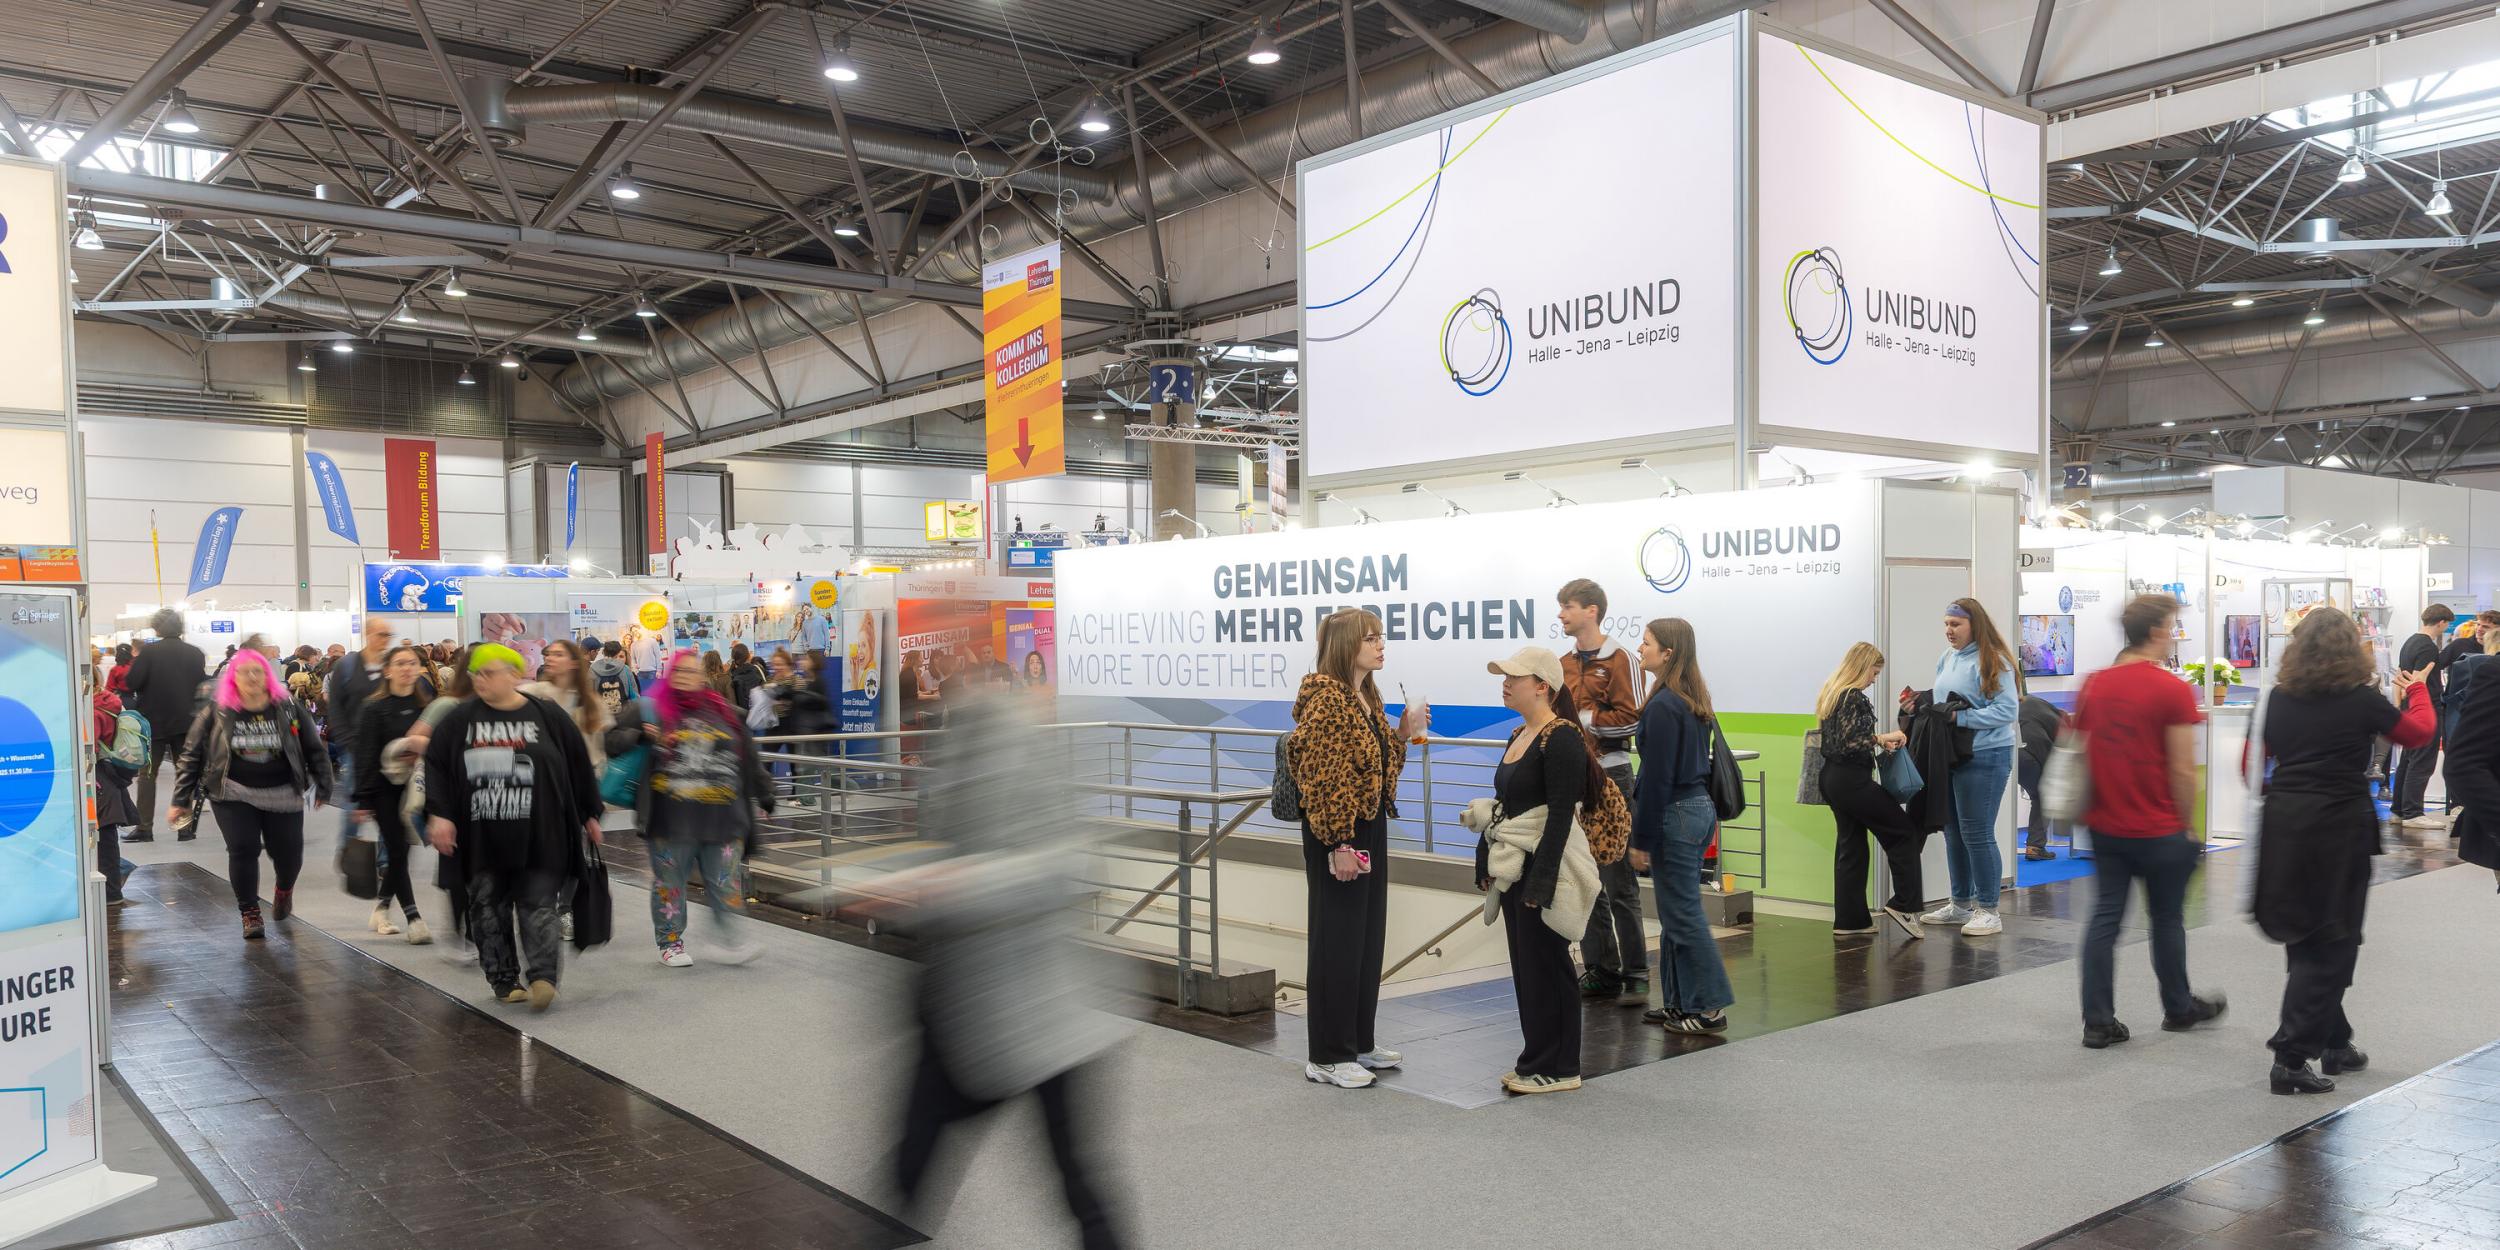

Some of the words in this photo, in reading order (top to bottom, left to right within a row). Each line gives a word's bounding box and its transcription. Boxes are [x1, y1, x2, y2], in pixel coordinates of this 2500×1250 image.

[1528, 278, 1681, 340] UNIBUND
[1866, 287, 1976, 339] UNIBUND
[996, 338, 1025, 367] KOMM
[1026, 329, 1043, 352] INS
[1528, 345, 1561, 364] Halle
[1576, 338, 1611, 355] Jena
[1628, 323, 1680, 346] Leipzig
[1866, 330, 1893, 350] Halle
[1904, 337, 1930, 356] Jena
[1941, 343, 1976, 367] Leipzig
[997, 346, 1049, 388] KOLLEGIUM
[1162, 368, 1177, 401] 2
[418, 451, 429, 489] Bildung
[2077, 468, 2087, 486] 2
[420, 491, 430, 550] Trendforum
[203, 525, 224, 582] sternchenverlag
[1702, 523, 1841, 559] UNIBUND
[1214, 553, 1408, 599] GEMEINSAM
[1702, 566, 1731, 578] Halle
[1747, 563, 1778, 576] Jena
[1796, 559, 1841, 575] Leipzig
[2021, 553, 2034, 567] D
[2036, 556, 2051, 564] 302
[907, 583, 943, 594] Thüringen
[1030, 585, 1053, 595] Lehre
[2216, 574, 2227, 587] D
[2427, 577, 2437, 588] D
[29, 609, 60, 622] Springer
[1009, 622, 1034, 633] GENIAL
[1034, 627, 1051, 635] DUAL
[1067, 609, 1205, 645] ACHIEVING
[1215, 607, 1304, 643] MEHR
[1603, 615, 1642, 638] 995
[900, 628, 969, 650] GEMEINSAM
[1068, 653, 1133, 685] MORE
[1142, 653, 1288, 688] TOGETHER
[842, 721, 853, 731] Jetzt
[854, 722, 863, 731] mit
[10, 752, 45, 761] Wissenschaft
[0, 965, 75, 1006] INGER
[1, 1006, 51, 1043] URE
